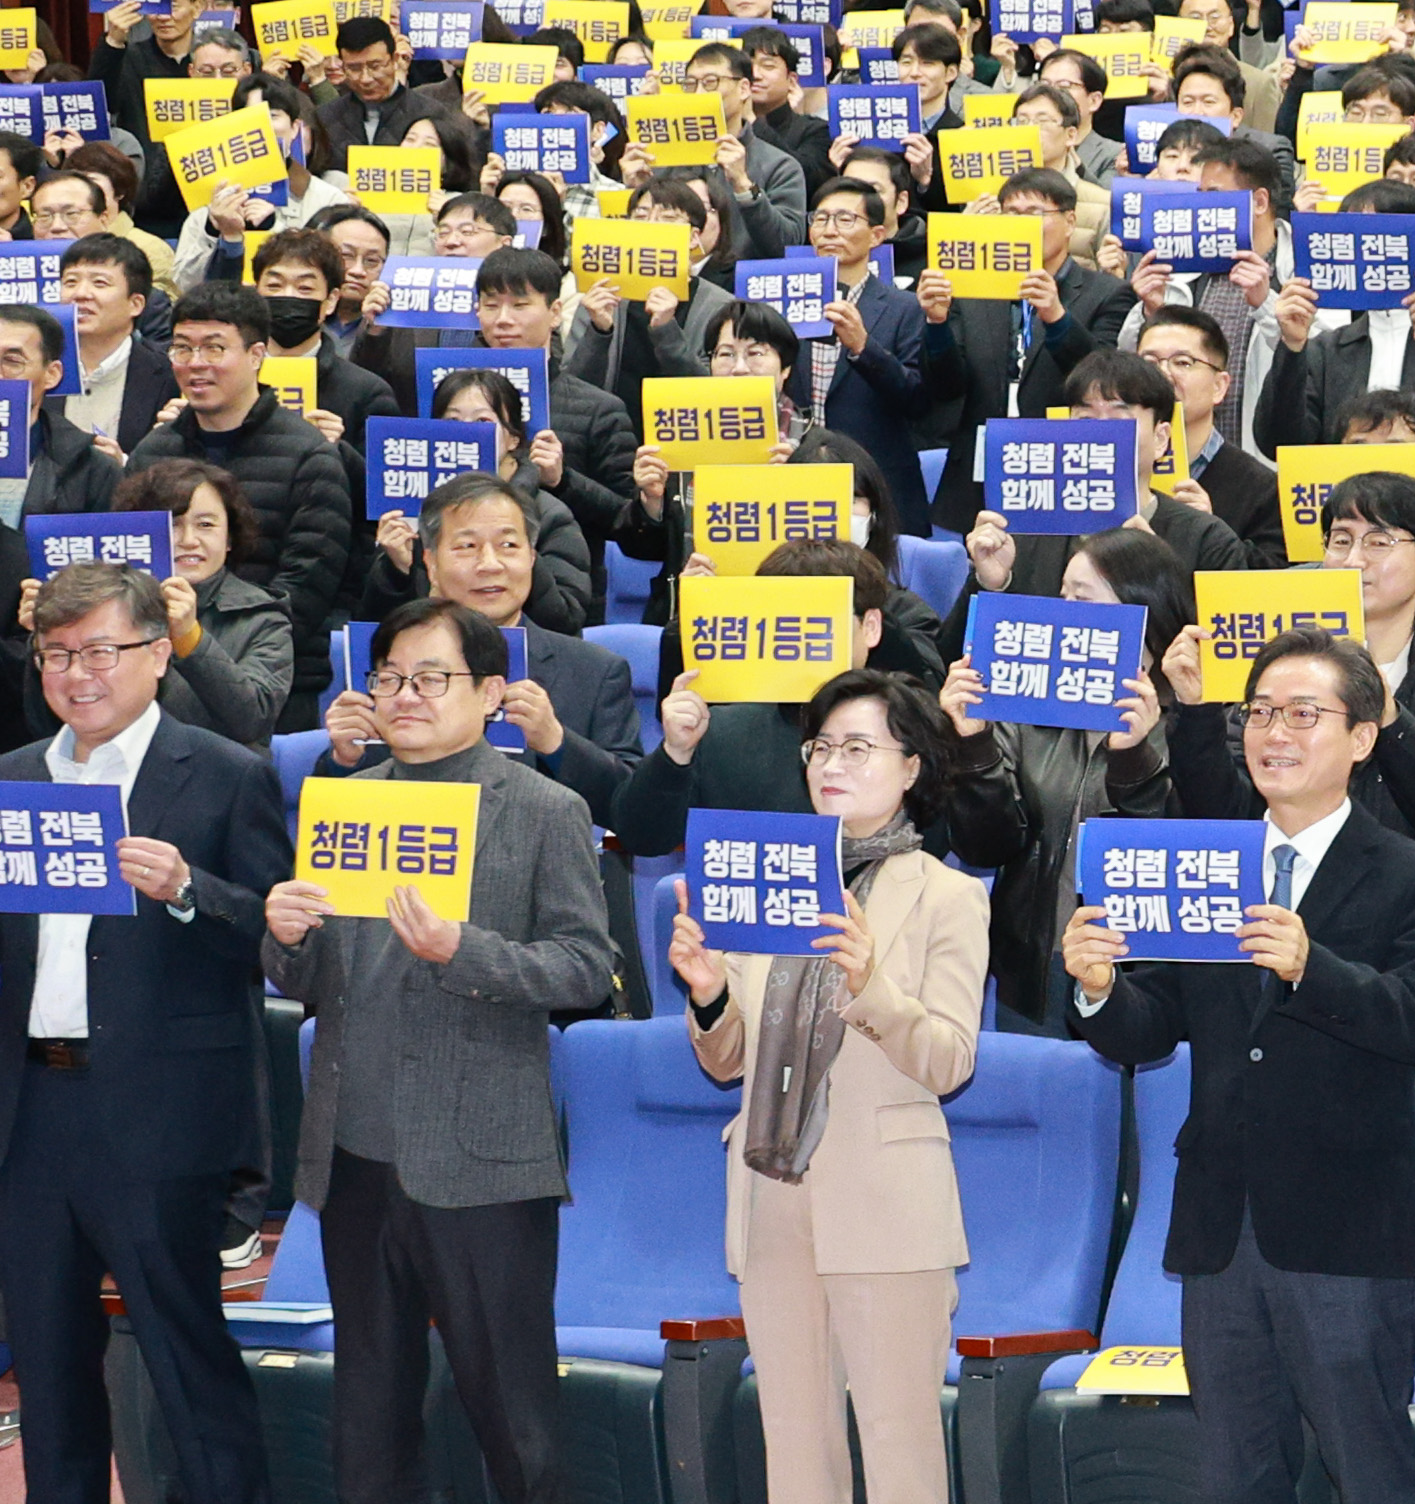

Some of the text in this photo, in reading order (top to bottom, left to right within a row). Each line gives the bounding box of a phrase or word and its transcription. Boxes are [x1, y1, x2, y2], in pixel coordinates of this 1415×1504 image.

[410, 12, 471, 29] 청렴 전북
[409, 30, 469, 48] 함께 성공
[839, 98, 907, 117] 청렴 전북
[505, 128, 575, 148] 청렴 전북
[840, 119, 910, 140] 함께 성공
[180, 129, 269, 185] 청렴1등급
[505, 150, 576, 173] 함께 성공
[1154, 208, 1236, 233] 청렴 전북
[1150, 234, 1237, 258] 함께 성공
[1309, 233, 1408, 260] 청렴 전북
[1310, 263, 1410, 290] 함께 성공
[391, 288, 472, 313] 함께 성공
[384, 438, 479, 469] 청렴 전북
[1003, 443, 1115, 474] 청렴 전북
[1002, 479, 1115, 510] 함께 성공
[707, 502, 838, 541] 청렴1등급
[693, 616, 832, 661] 청렴1등급
[995, 621, 1119, 664] 청렴 전북
[991, 660, 1114, 704] 함께 성공
[40, 812, 103, 846] 전북
[311, 821, 458, 875] 청렴1등급
[704, 840, 816, 882] 청렴 전북
[45, 852, 107, 886] 성공
[1104, 849, 1239, 889] 청렴 전북
[703, 888, 820, 926] 함께 성공
[1104, 895, 1243, 933] 함께 성공
